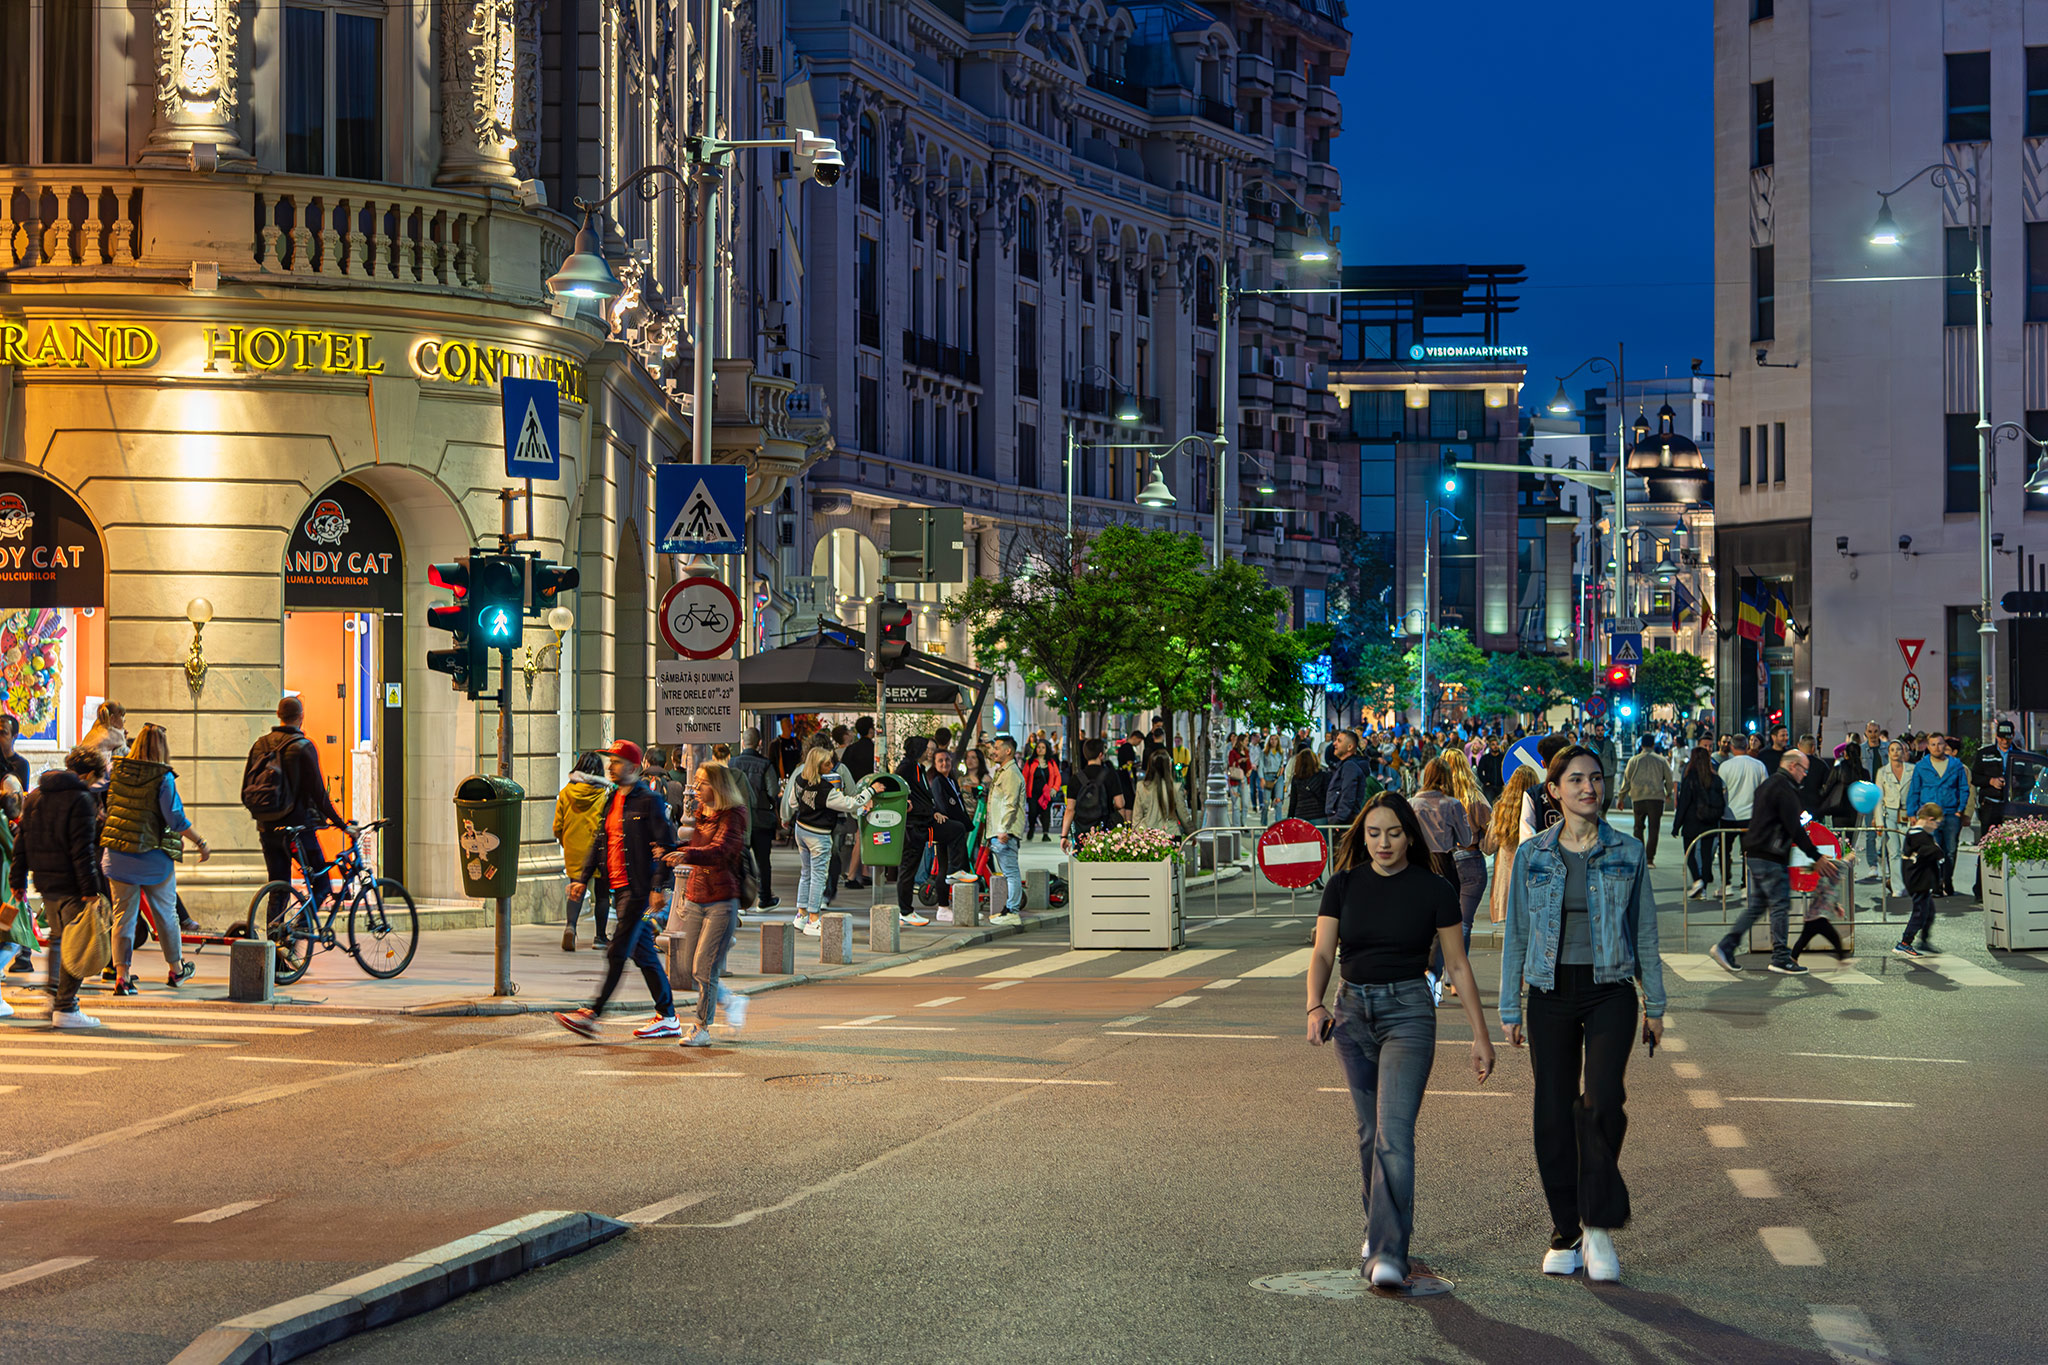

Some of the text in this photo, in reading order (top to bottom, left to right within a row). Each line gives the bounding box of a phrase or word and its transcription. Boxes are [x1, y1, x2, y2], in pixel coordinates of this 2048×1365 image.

[203, 327, 385, 371] HOTEL
[1425, 346, 1528, 357] VISIONAPARTMENTS
[32, 546, 85, 569] CAT
[347, 552, 393, 574] CAT
[0, 572, 56, 581] ULCIURILOR
[286, 575, 369, 585] LUMEA DULCIURILOR
[701, 671, 734, 682] DUMINICĂ
[661, 688, 682, 700] ÎNTRE
[683, 690, 707, 699] ORELE
[664, 706, 731, 716] INTERZIS BICICLETE
[684, 722, 721, 732] TROTINETE
